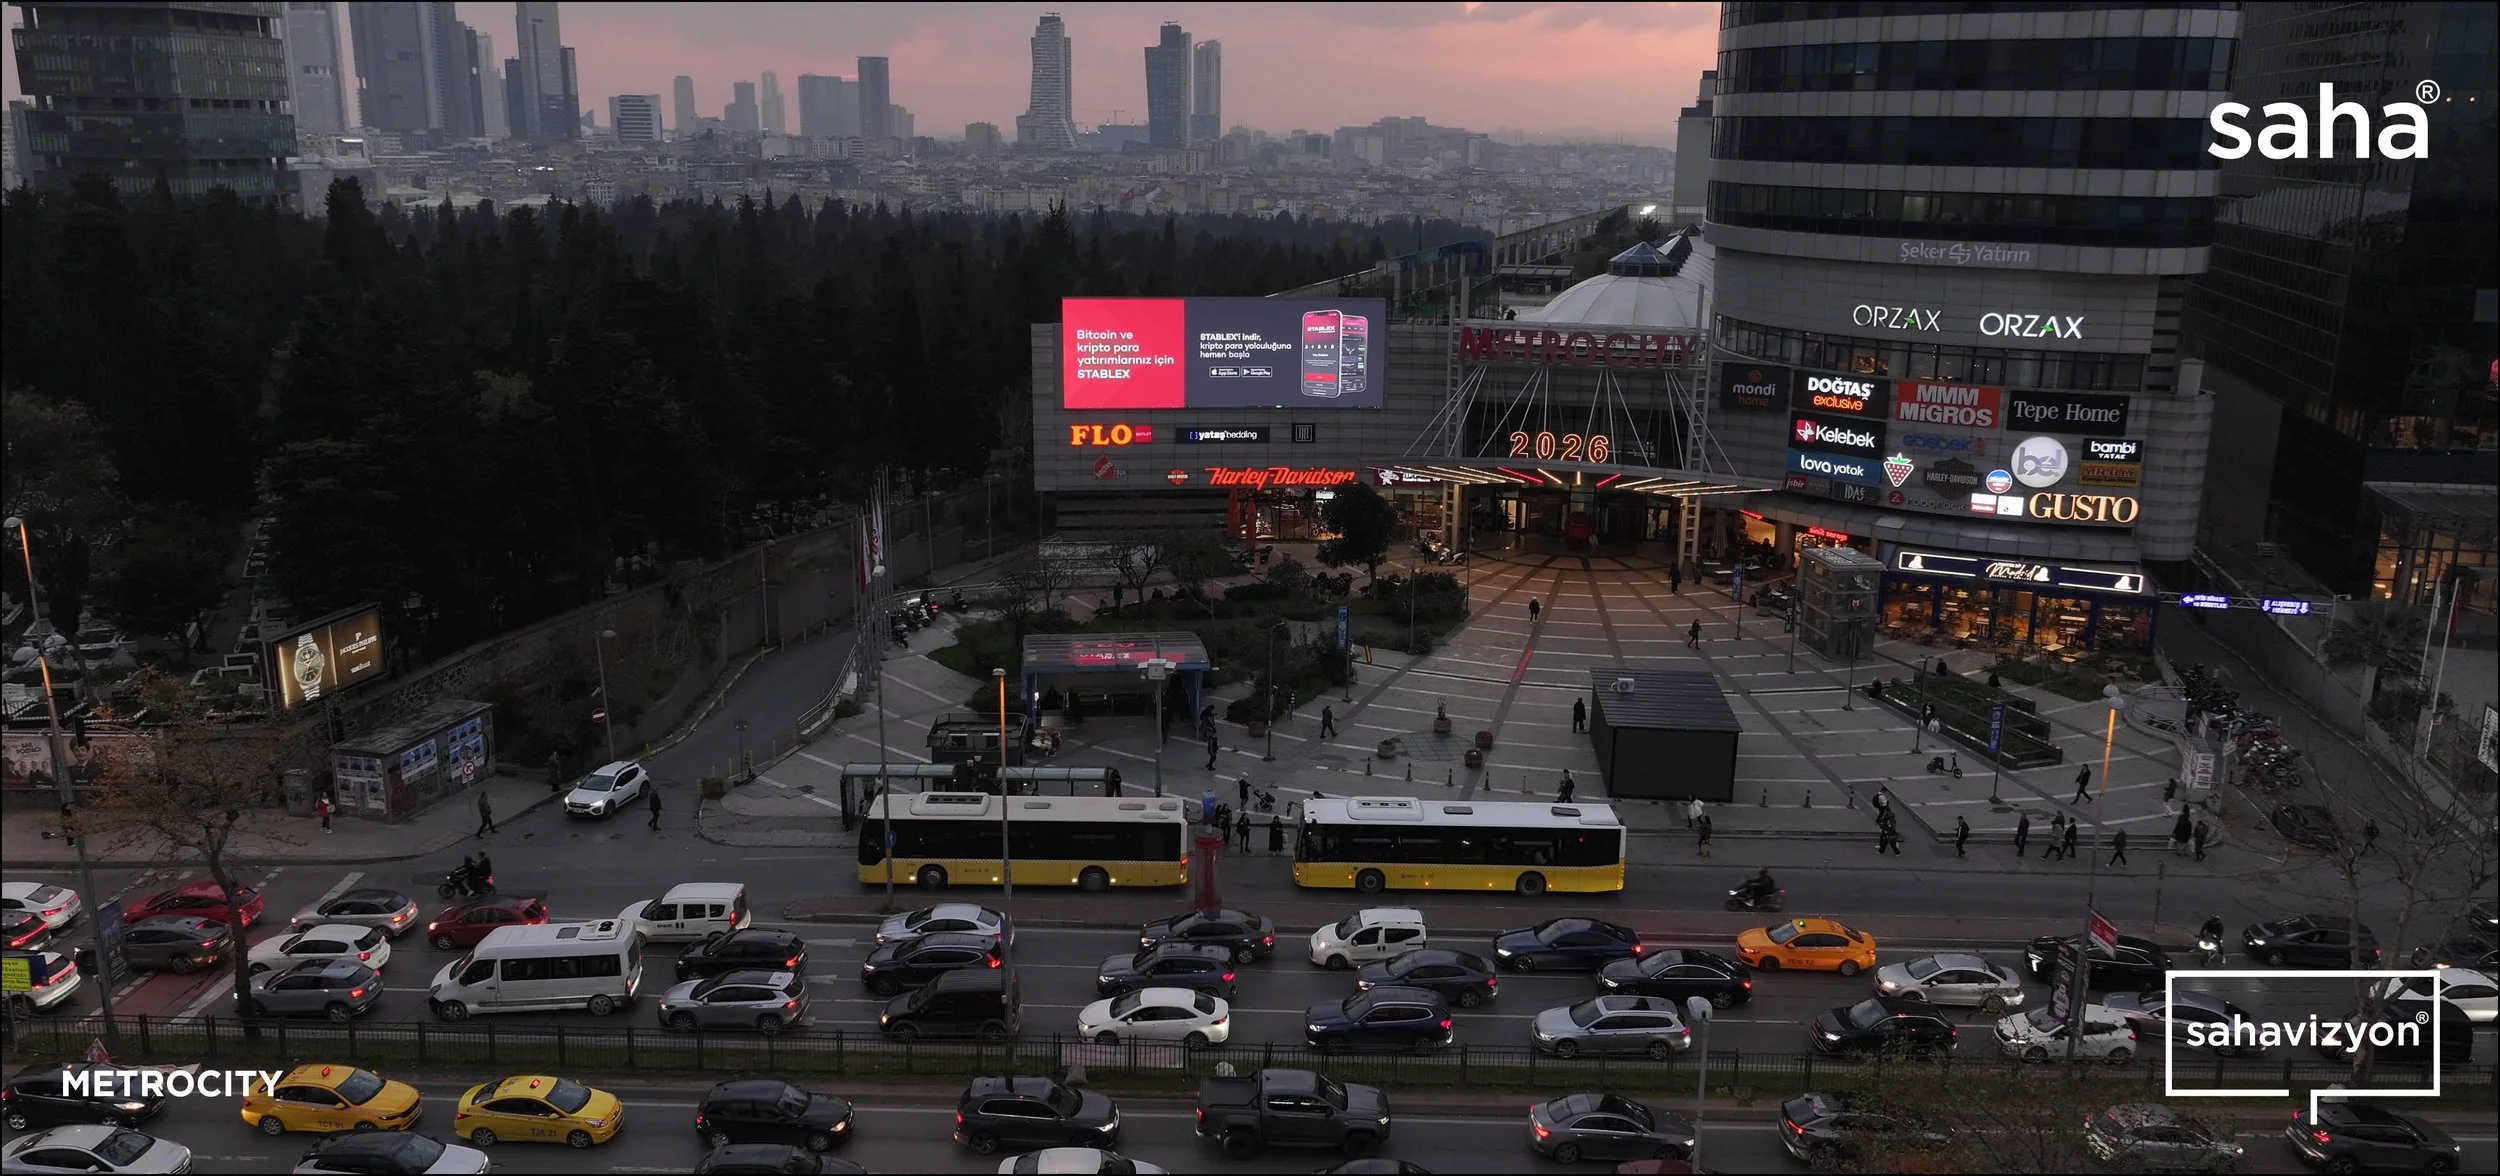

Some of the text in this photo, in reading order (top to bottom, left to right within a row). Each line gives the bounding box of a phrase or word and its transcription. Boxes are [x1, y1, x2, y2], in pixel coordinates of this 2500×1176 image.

[1901, 242, 1946, 263] Şeker
[1853, 304, 1942, 332] ORZAX
[1979, 312, 2085, 340] ORZAX
[1077, 330, 1133, 340] Bitcoin ve
[1200, 333, 1262, 341] STABLEX'i indir,
[1077, 342, 1139, 355] kripto para
[1200, 342, 1224, 351] kripto
[1244, 342, 1292, 351] yolculuğuna
[1458, 326, 1698, 370] METROCITY
[1077, 355, 1175, 367] yatırımlarınız için
[1228, 351, 1250, 359] başla
[1077, 369, 1131, 379] STABLEX
[1732, 383, 1776, 396] mondi
[1808, 376, 1872, 401] DOĞTAŞ
[1916, 384, 1979, 407] MMM
[1738, 395, 1769, 406] home
[1813, 395, 1863, 411] exclusive
[1900, 402, 1993, 427] MiGROS
[2013, 401, 2121, 423] Tepe Home
[1070, 424, 1133, 445] FLO
[1198, 430, 1258, 441] yataş bedding
[1815, 425, 1876, 449] Kelebek
[1509, 431, 1609, 464] 2026
[2090, 440, 2137, 454] bambi
[1800, 454, 1864, 477] lova yatak
[1204, 466, 1358, 490] Harley-Davidson
[1926, 472, 1978, 485] HARLEY-DAVIDSON
[1905, 497, 1966, 512] roborock
[2028, 491, 2139, 523] GUSTO
[1808, 526, 1825, 536] simit
